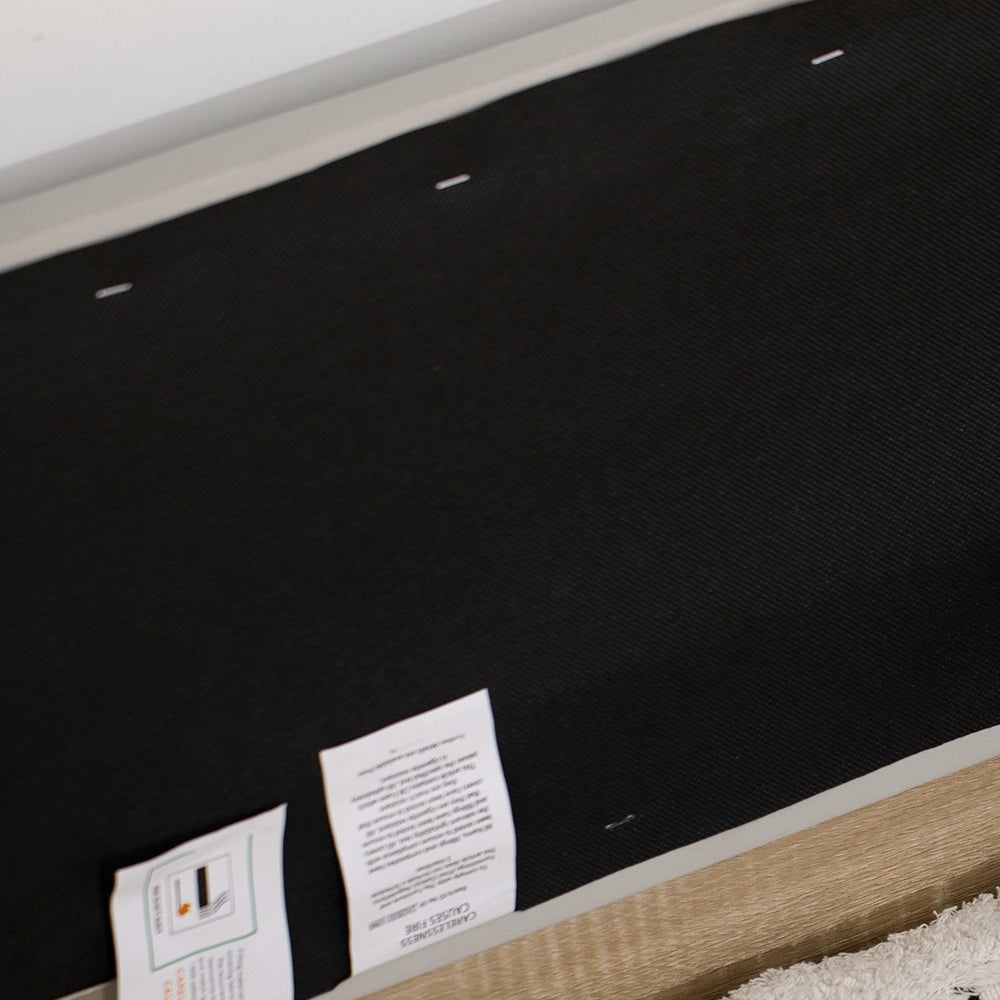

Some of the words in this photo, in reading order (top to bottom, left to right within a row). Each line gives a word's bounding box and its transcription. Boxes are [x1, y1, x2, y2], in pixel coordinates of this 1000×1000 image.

[430, 903, 469, 925] CAUSES
[401, 912, 476, 947] CARELESSNESS
[406, 920, 427, 935] FIRE
